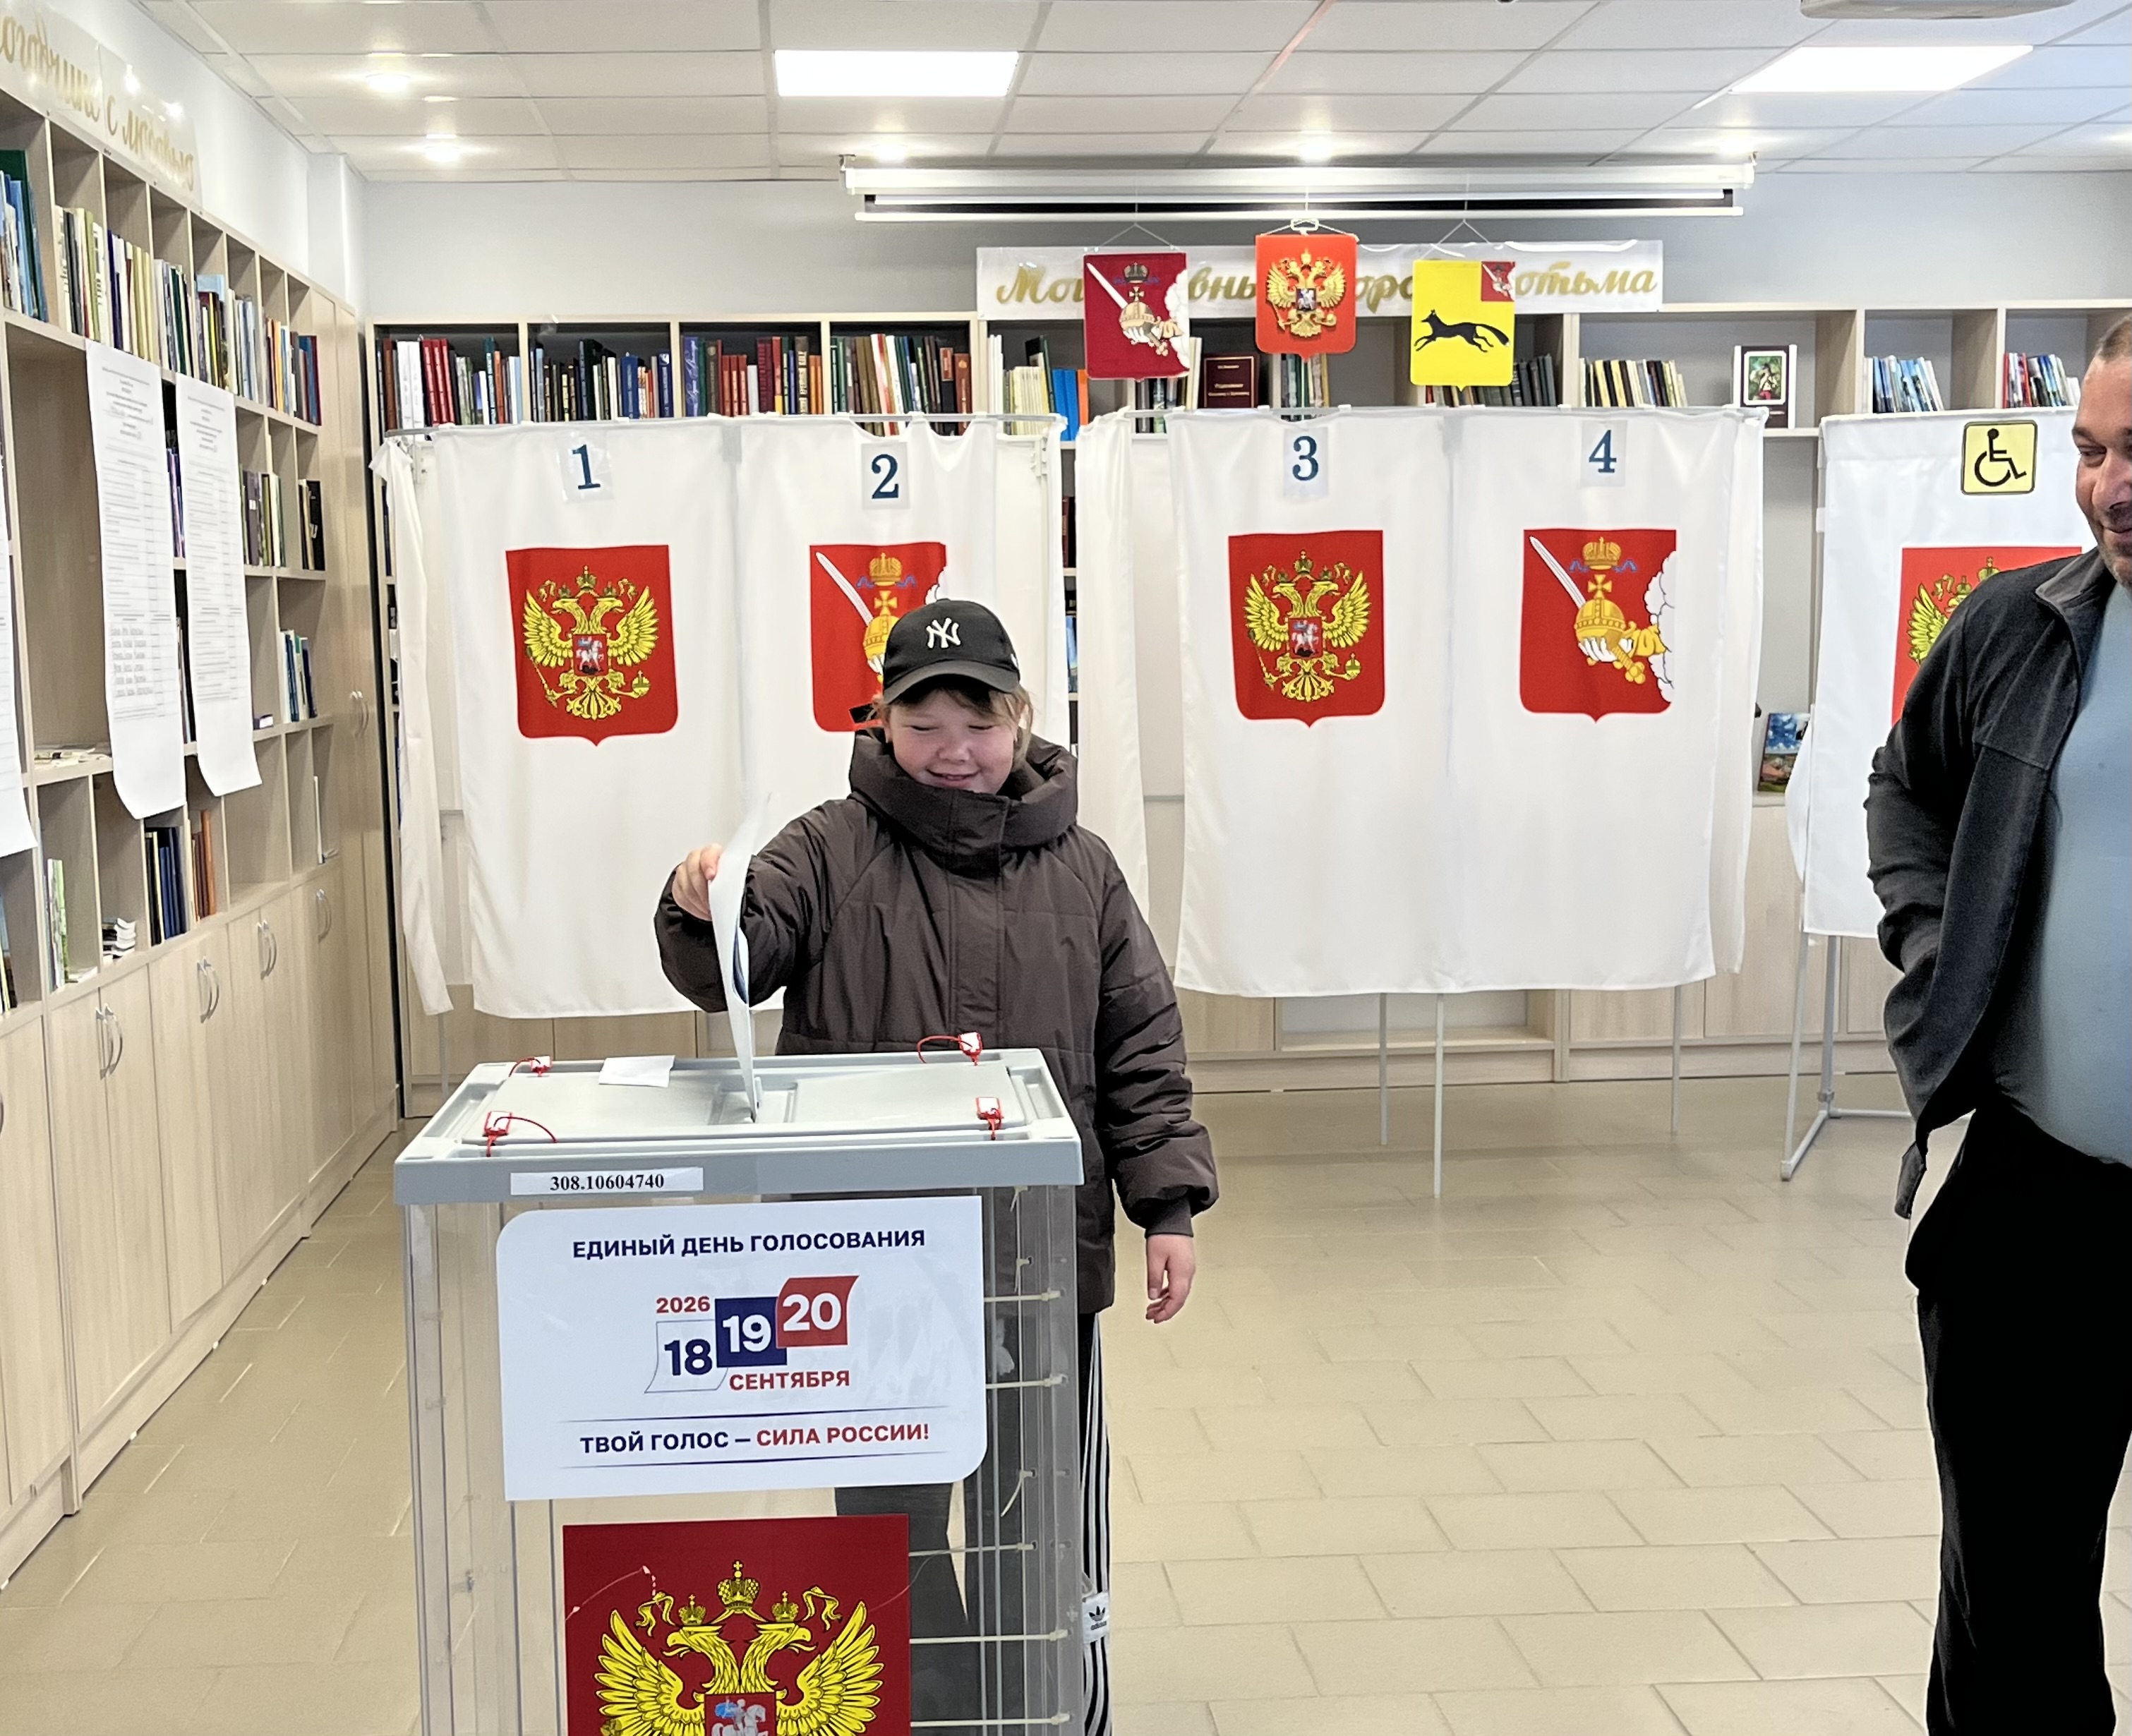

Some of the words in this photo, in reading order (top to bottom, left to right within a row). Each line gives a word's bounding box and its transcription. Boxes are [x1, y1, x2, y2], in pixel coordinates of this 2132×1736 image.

[1356, 273, 1413, 313] оро
[1515, 260, 1658, 296] отьма
[572, 444, 601, 490] 1
[1292, 435, 1318, 481] 3
[1589, 430, 1617, 473] 4
[871, 454, 899, 502] 2
[926, 617, 961, 649] NY
[550, 1174, 665, 1192] 308.10604740
[572, 1234, 675, 1260] ЕДИНЫЙ
[680, 1236, 745, 1258] ДЕНЬ
[750, 1229, 926, 1252] ГОЛОСОВАНИЯ
[656, 1296, 711, 1314] 2026
[663, 1339, 713, 1377] 18
[723, 1314, 772, 1353] 19
[783, 1293, 842, 1331] 20
[729, 1370, 851, 1391] СЕНТЯБРЯ
[579, 1430, 644, 1454] ТВОЙ
[651, 1431, 730, 1451] ГОЛОС
[756, 1428, 821, 1447] СИЛА
[826, 1423, 929, 1443] РОССИИ!
